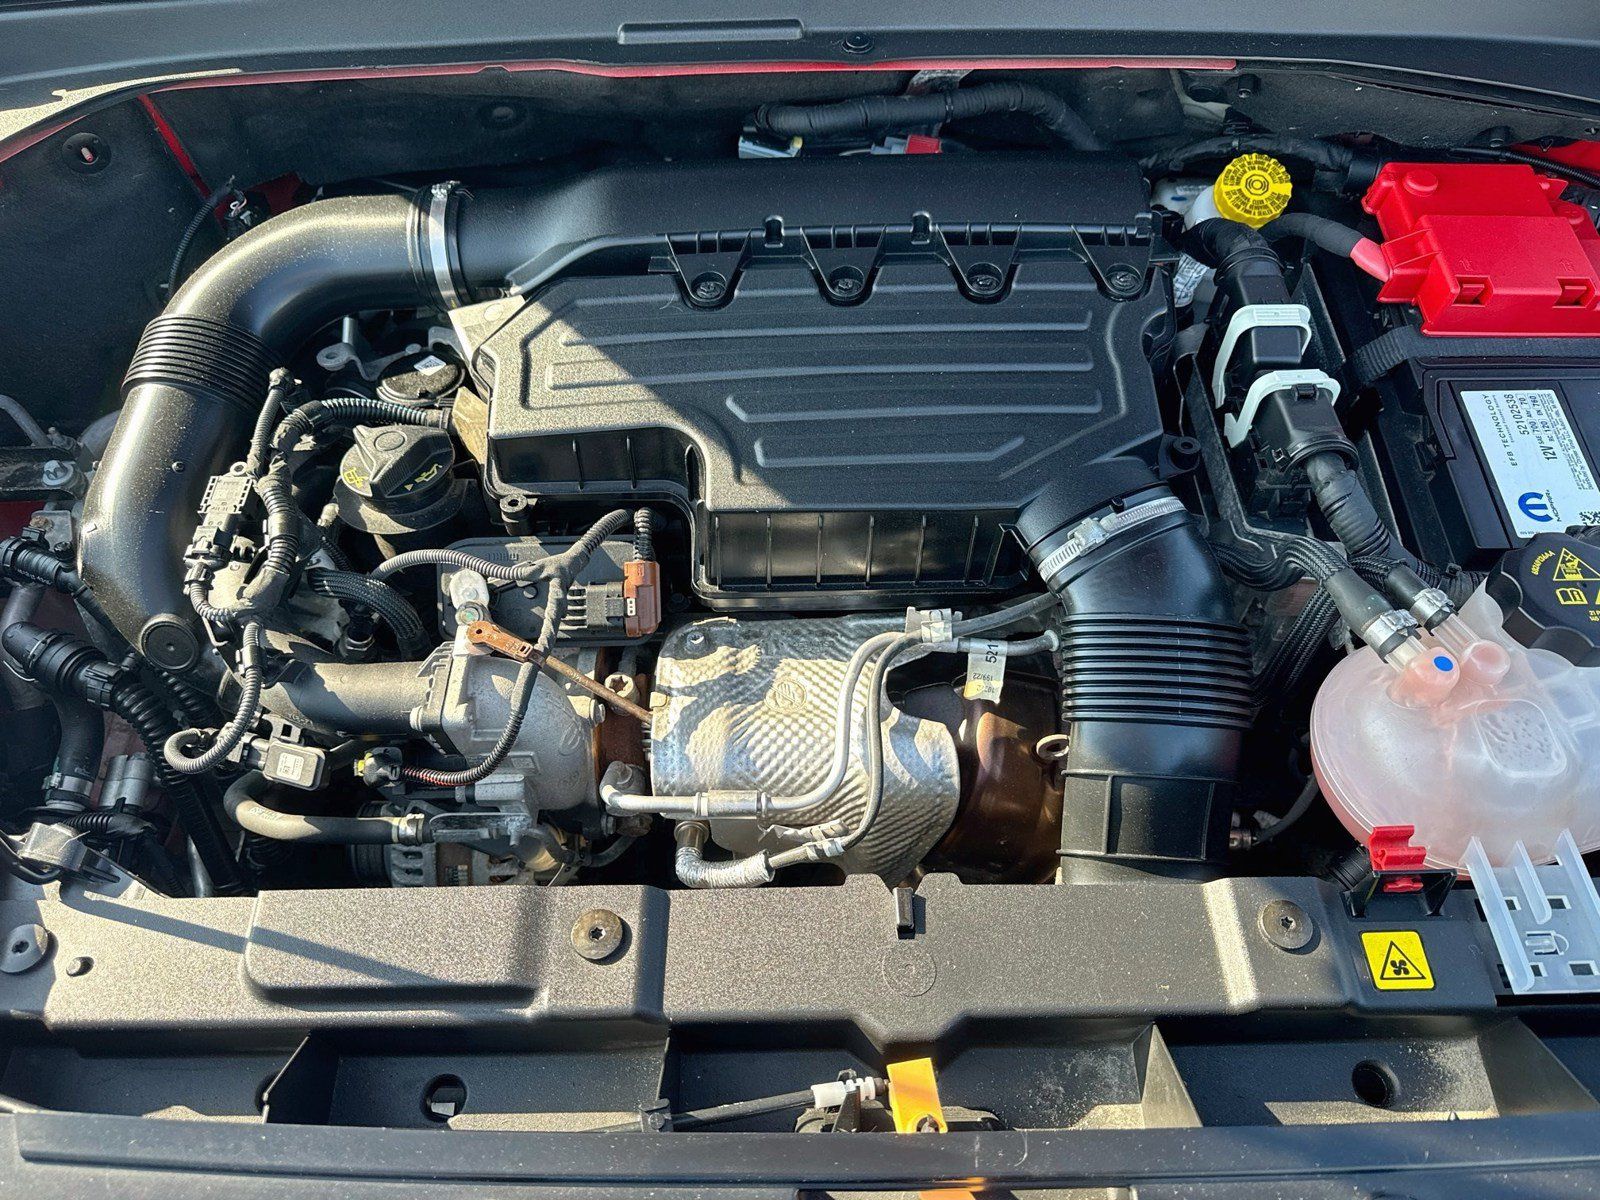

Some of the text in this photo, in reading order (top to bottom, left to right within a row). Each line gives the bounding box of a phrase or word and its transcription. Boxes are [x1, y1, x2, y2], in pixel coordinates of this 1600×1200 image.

[1519, 397, 1528, 405] 70
[1482, 394, 1518, 467] EFB TECHNOLOGY
[1528, 421, 1540, 433] 700
[1541, 420, 1552, 433] 120
[1540, 445, 1558, 461] 12V
[985, 644, 999, 664] 521
